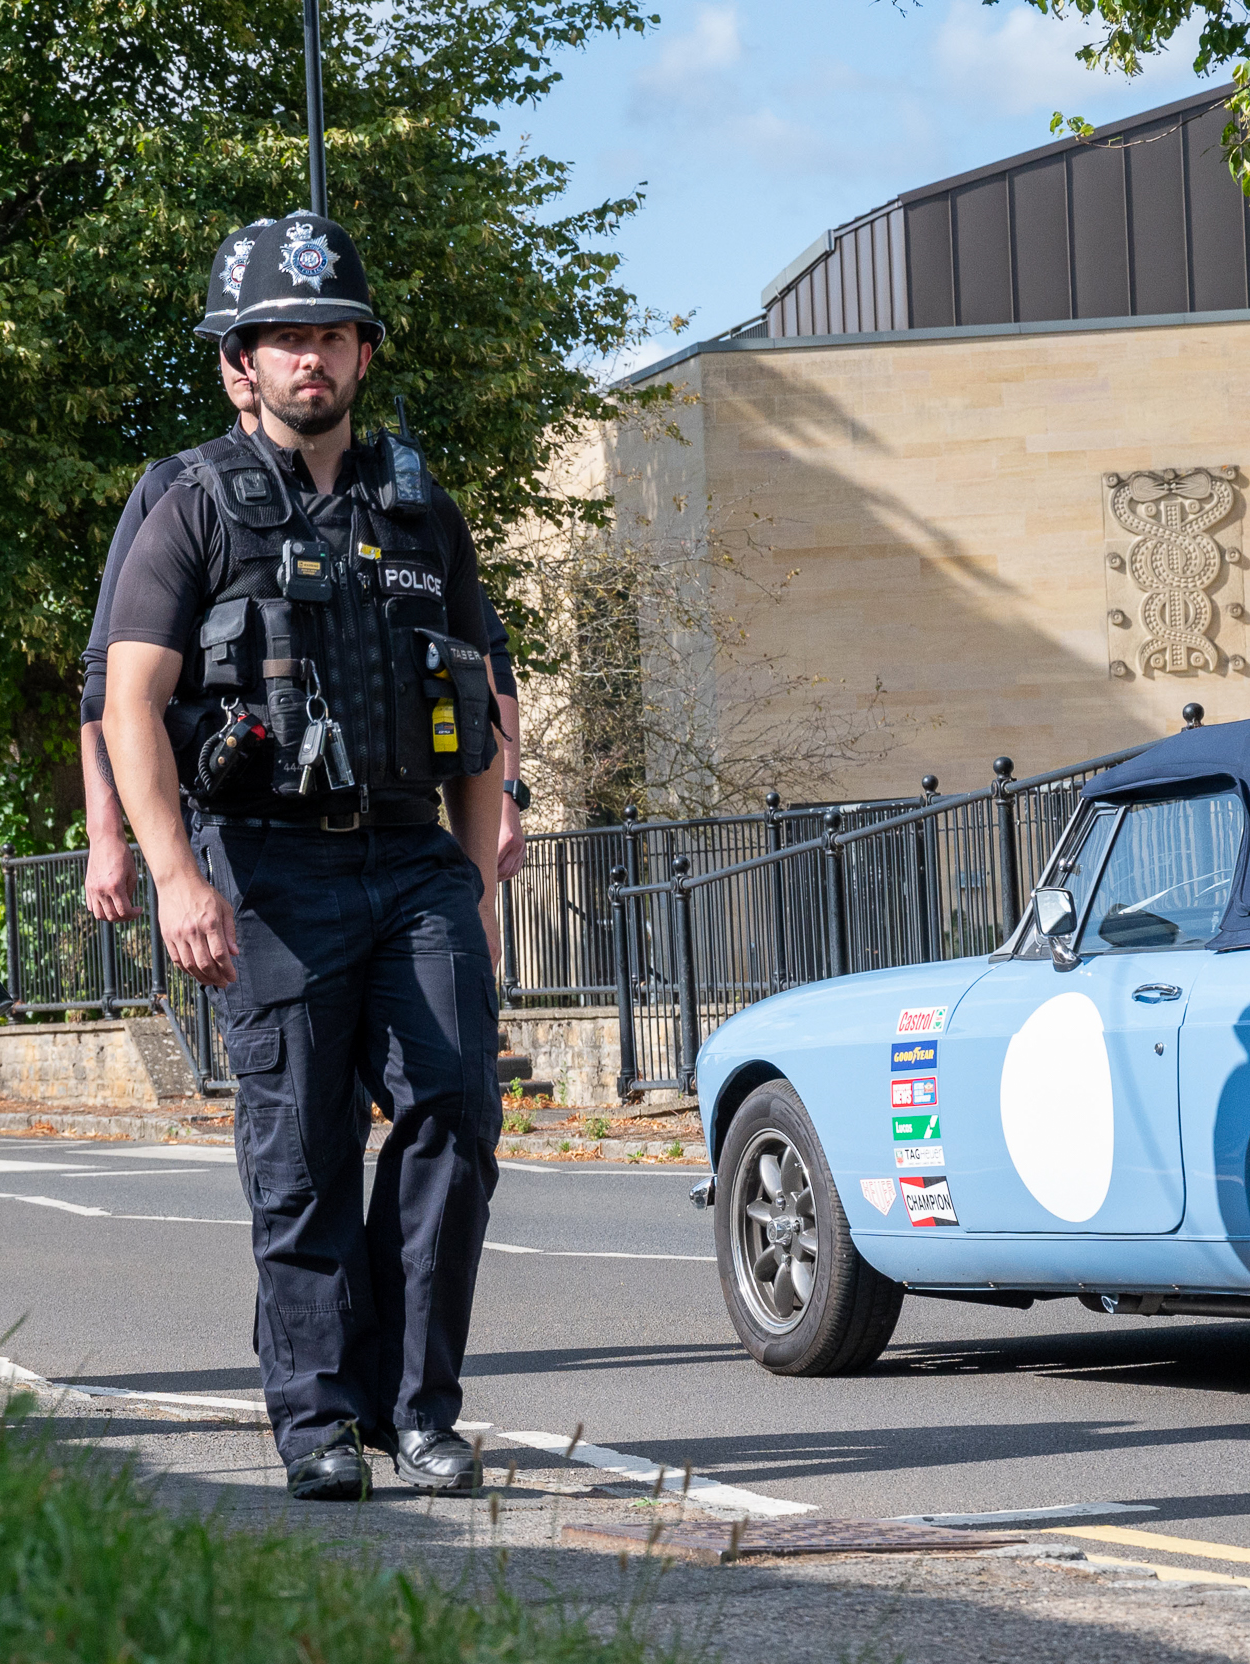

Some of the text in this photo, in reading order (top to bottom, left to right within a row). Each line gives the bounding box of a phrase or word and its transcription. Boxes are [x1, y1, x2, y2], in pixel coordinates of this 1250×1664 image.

[385, 569, 442, 597] POLICE
[451, 648, 482, 660] TASER
[899, 1010, 935, 1032] Castrol
[894, 1047, 934, 1064] GOODYEAR
[893, 1090, 912, 1104] NEWS
[906, 1194, 952, 1211] CHAMPION
